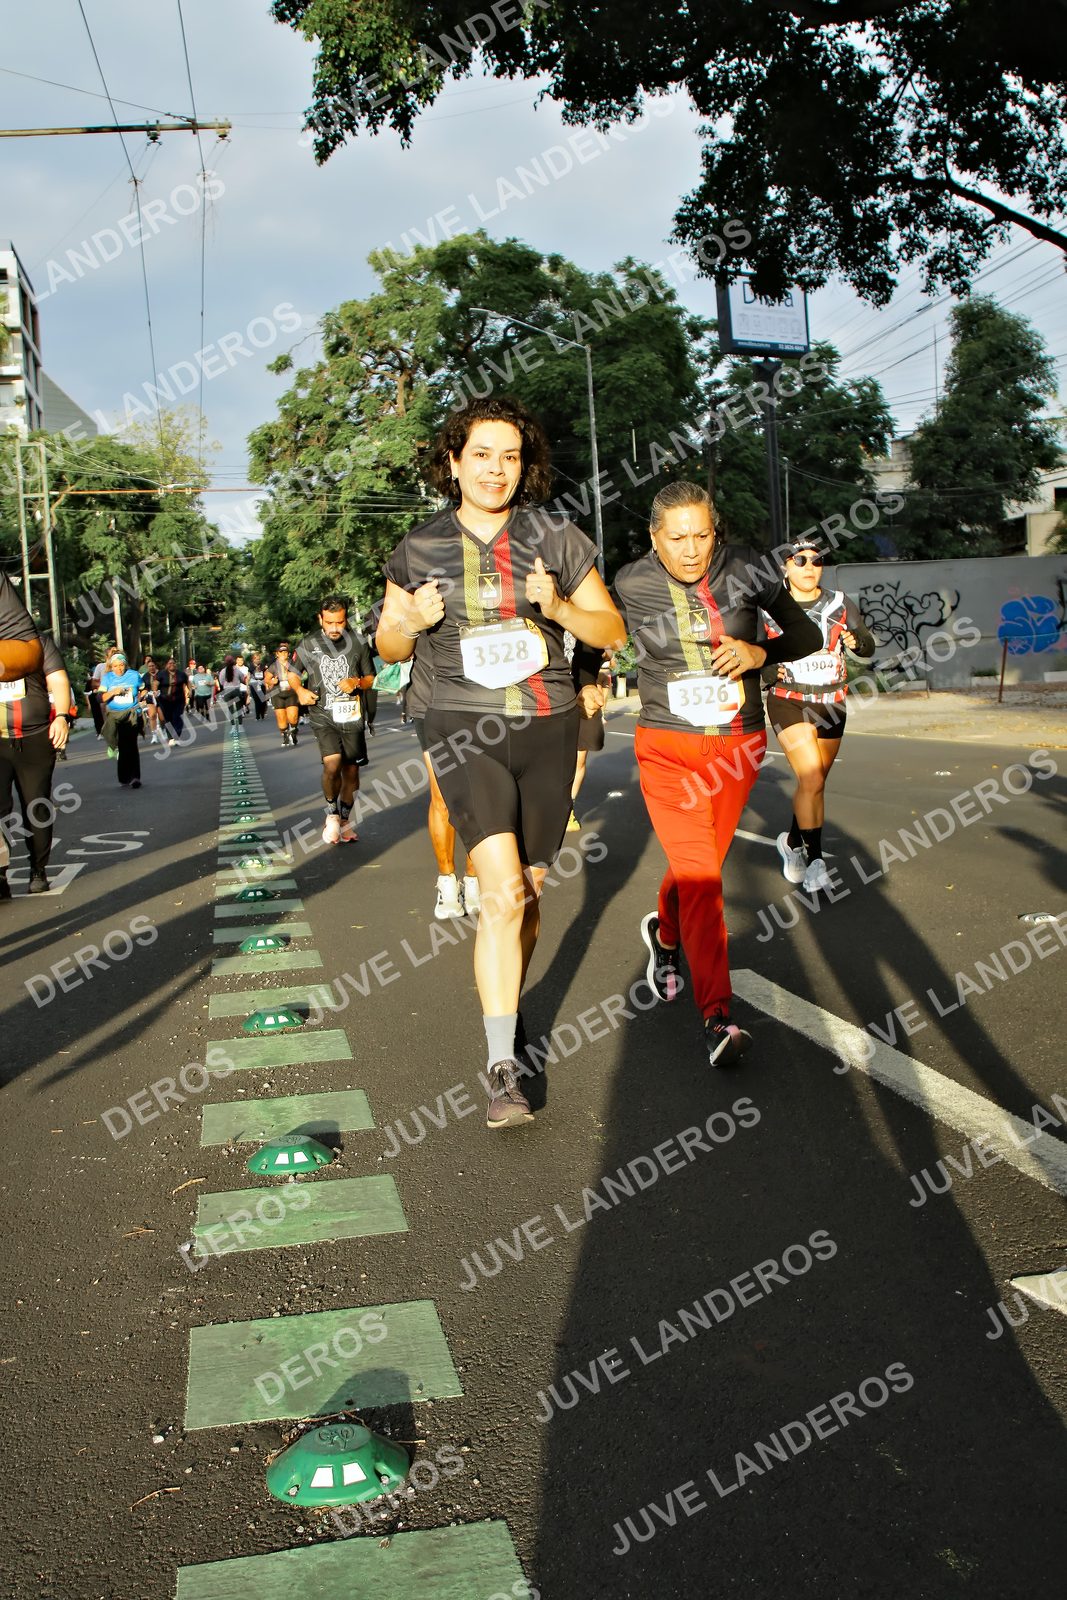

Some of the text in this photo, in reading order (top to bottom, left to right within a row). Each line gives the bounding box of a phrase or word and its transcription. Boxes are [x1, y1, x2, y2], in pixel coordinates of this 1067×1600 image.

[859, 580, 901, 596] TOY
[473, 639, 529, 668] 3528
[679, 684, 729, 708] 3526
